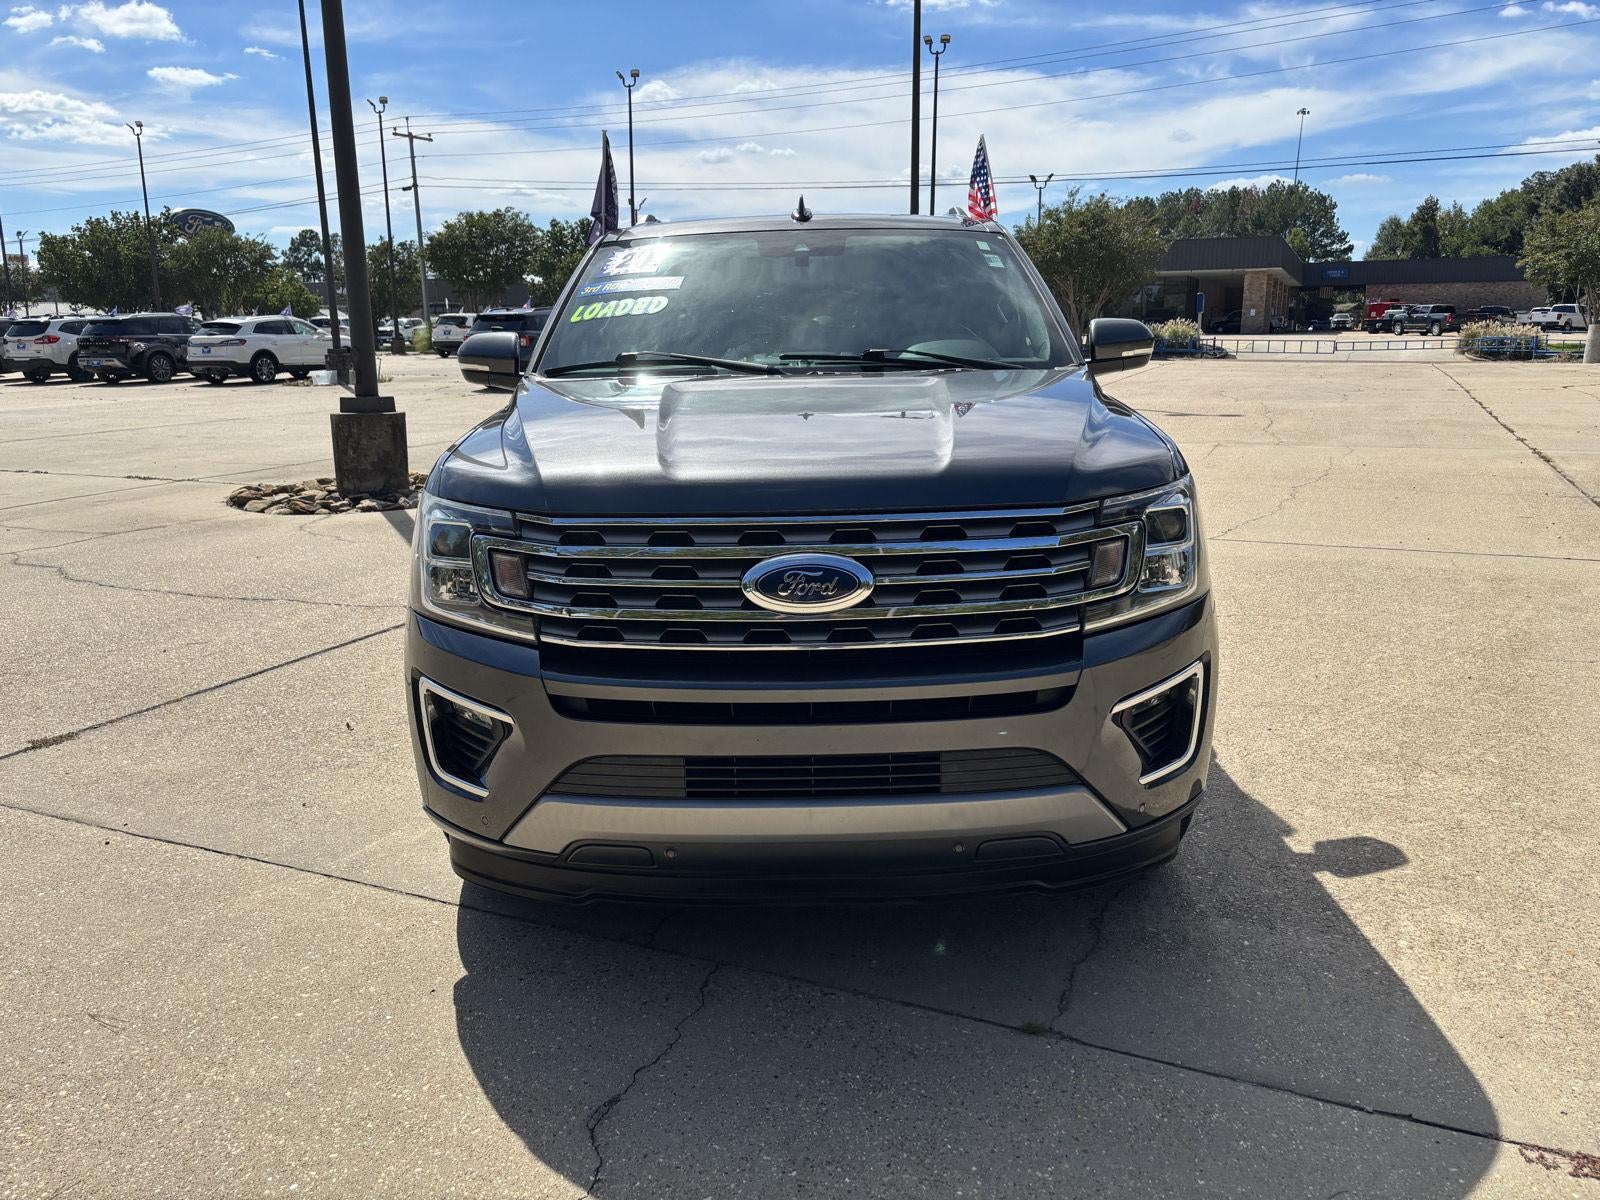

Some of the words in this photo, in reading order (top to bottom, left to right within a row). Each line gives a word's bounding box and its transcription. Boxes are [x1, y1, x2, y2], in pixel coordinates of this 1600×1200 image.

[581, 284, 602, 295] 3rd
[571, 296, 668, 322] LOADED
[777, 570, 838, 596] Ford
